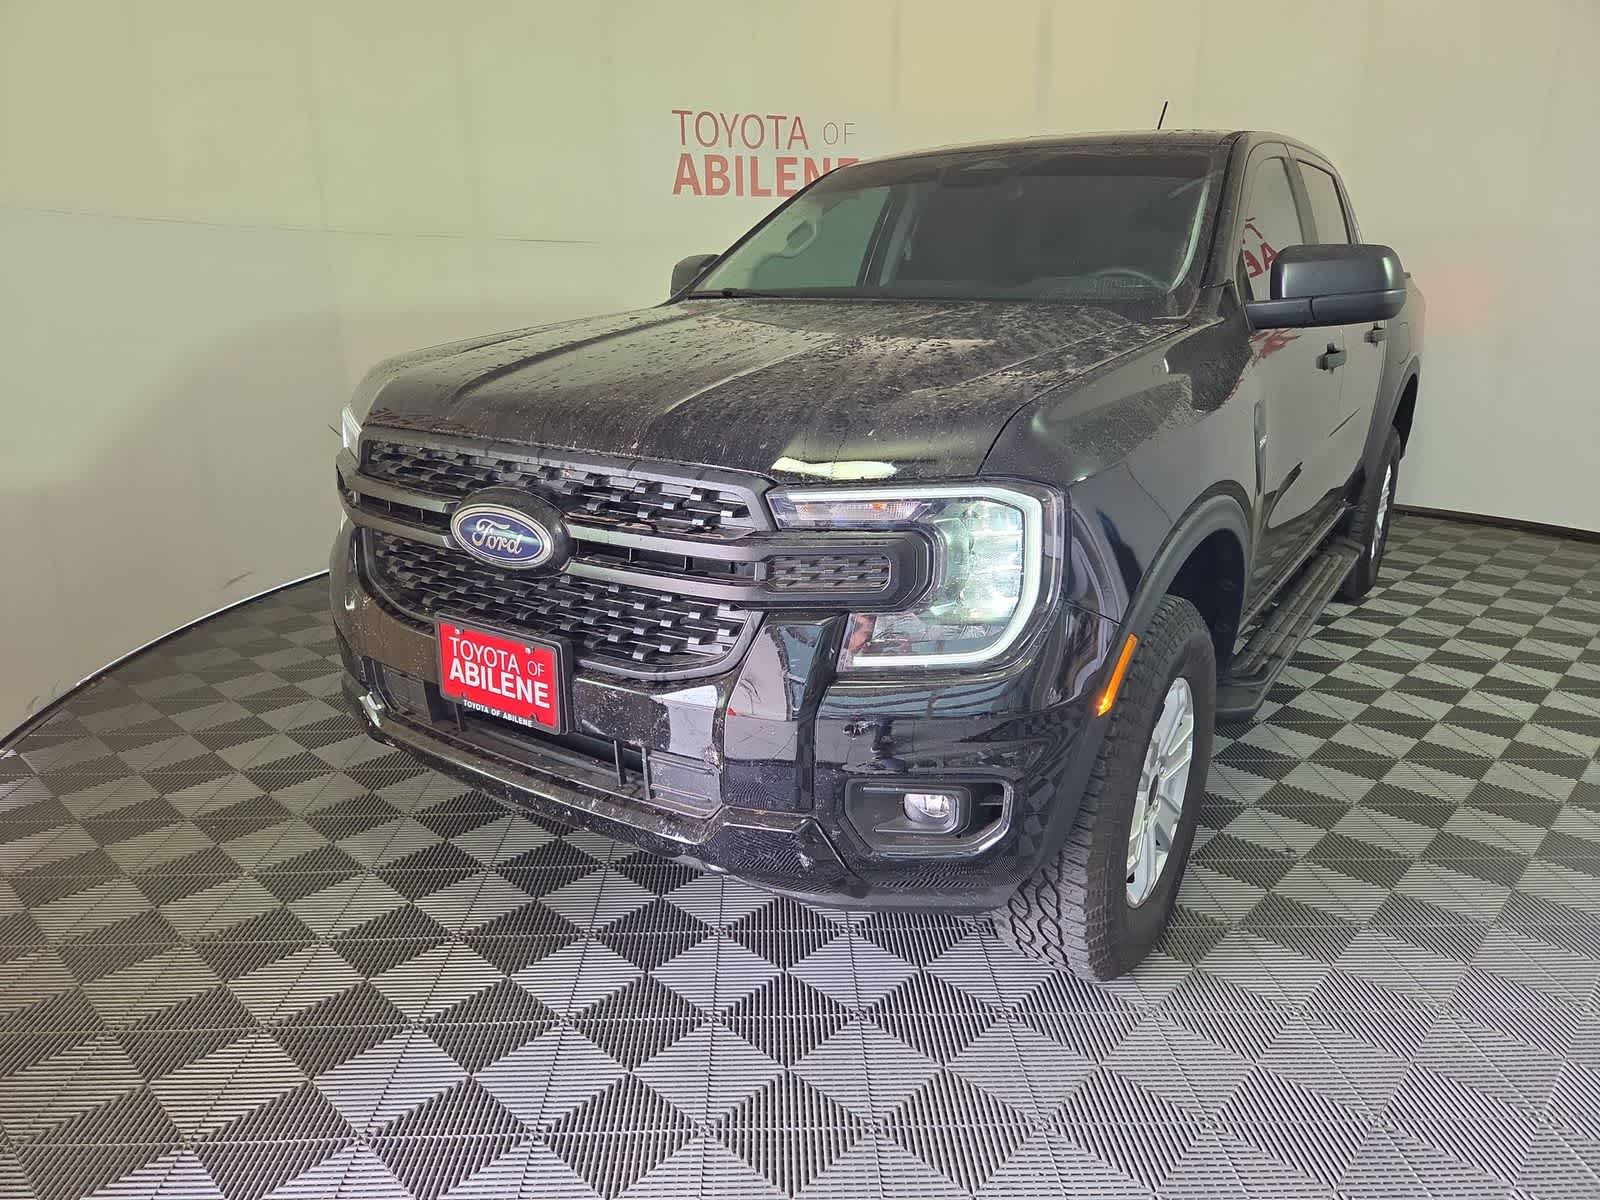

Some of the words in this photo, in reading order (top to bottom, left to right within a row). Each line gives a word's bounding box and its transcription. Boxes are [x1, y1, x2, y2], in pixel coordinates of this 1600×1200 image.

[671, 109, 809, 150] TOYOTA
[823, 121, 856, 145] OF
[672, 152, 860, 198] ABILEN
[471, 518, 522, 555] Ford
[448, 636, 520, 675] TOYOTA
[527, 660, 545, 677] OF
[449, 658, 550, 709] ABILENE
[463, 699, 489, 713] TOYOTA
[490, 708, 500, 717] OF
[502, 711, 533, 728] ABILENE
